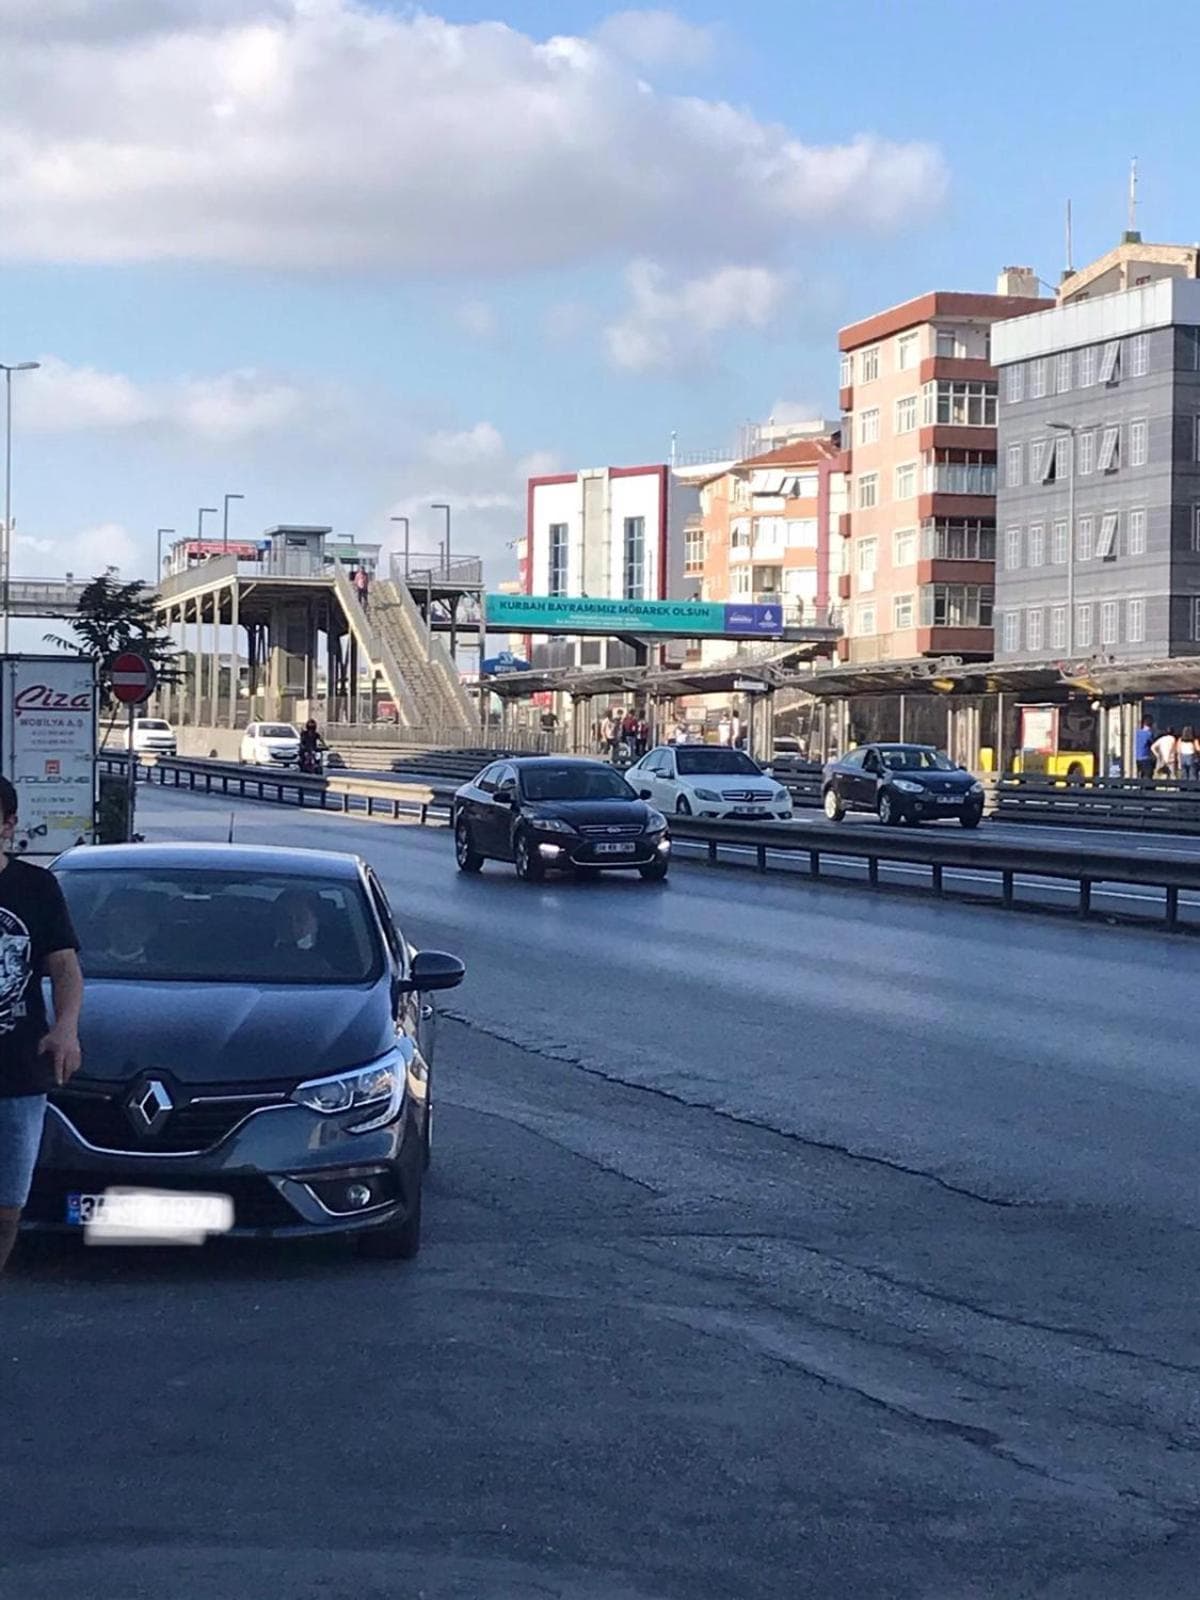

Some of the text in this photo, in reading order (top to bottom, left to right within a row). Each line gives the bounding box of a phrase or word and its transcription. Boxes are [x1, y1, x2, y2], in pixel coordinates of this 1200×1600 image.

[499, 600, 545, 611] KURBAN
[618, 603, 670, 616] MÜBAREK
[672, 606, 710, 617] OLSUN
